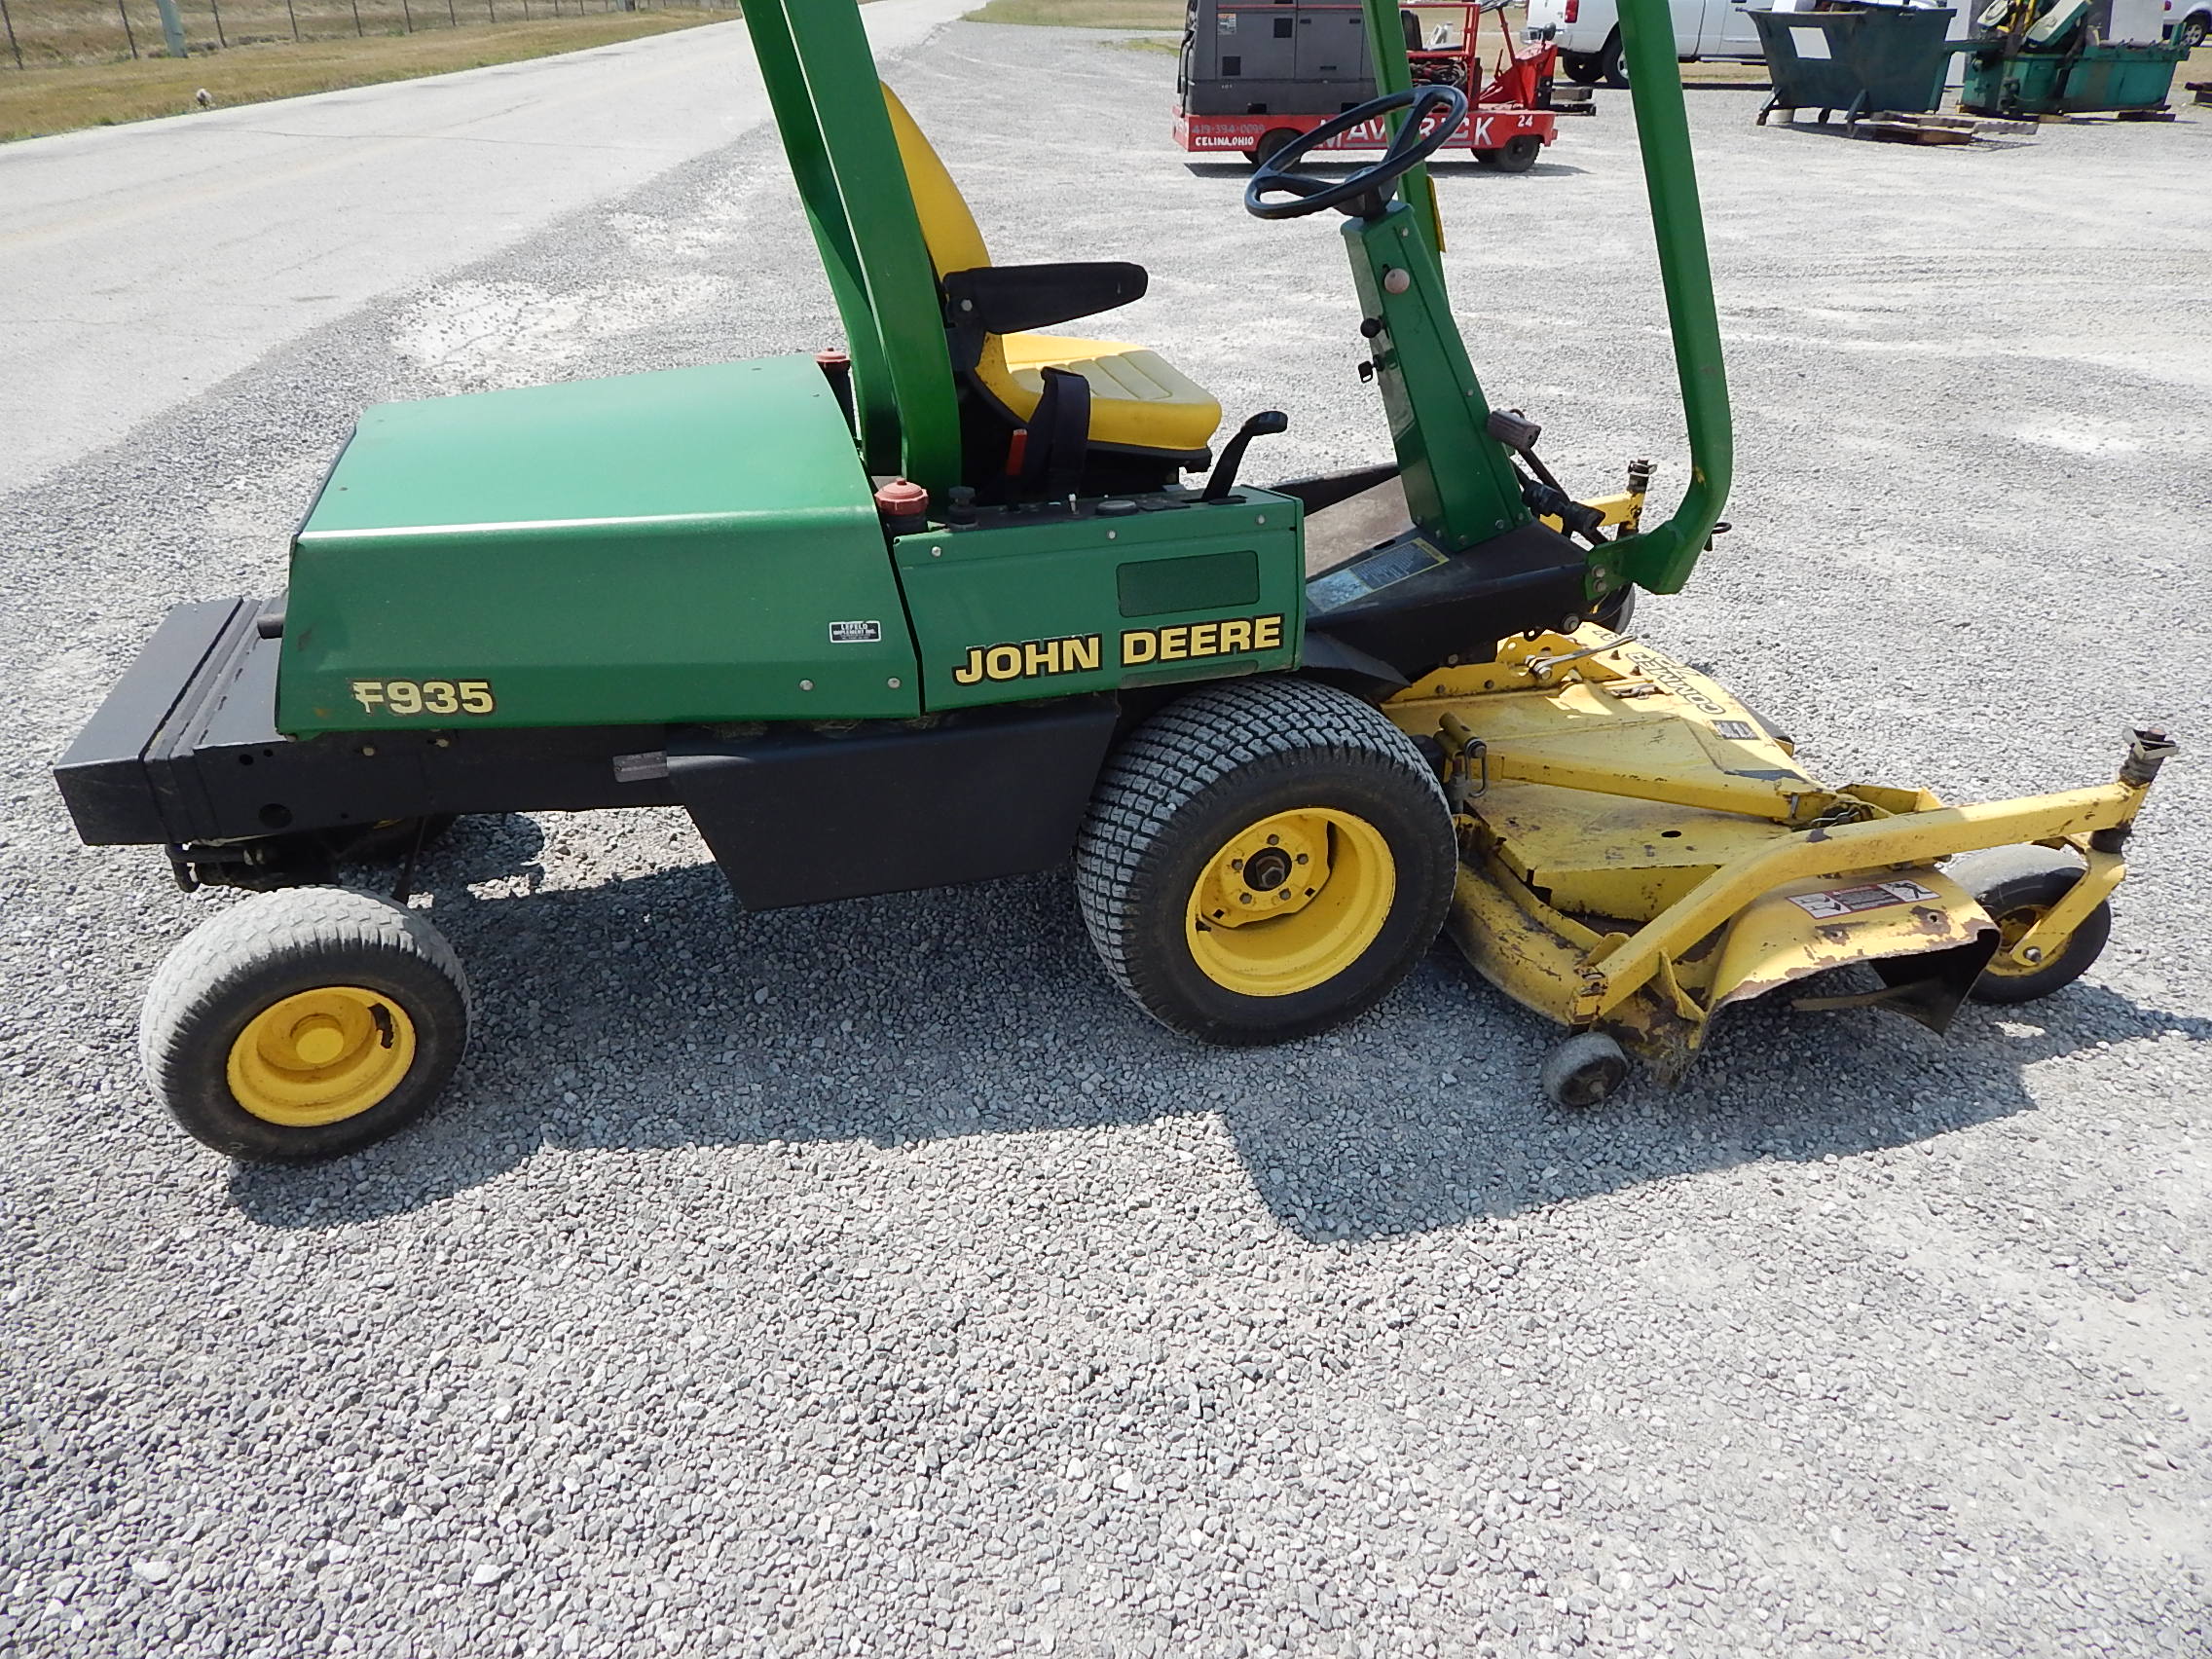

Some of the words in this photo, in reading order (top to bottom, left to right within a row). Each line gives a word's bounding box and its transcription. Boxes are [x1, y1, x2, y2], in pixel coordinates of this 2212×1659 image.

[1315, 116, 1494, 148] MAVRCK
[1517, 114, 1533, 128] 24
[954, 635, 1101, 684] JOHN
[1121, 614, 1283, 665] DEERE
[351, 681, 495, 716] F935
